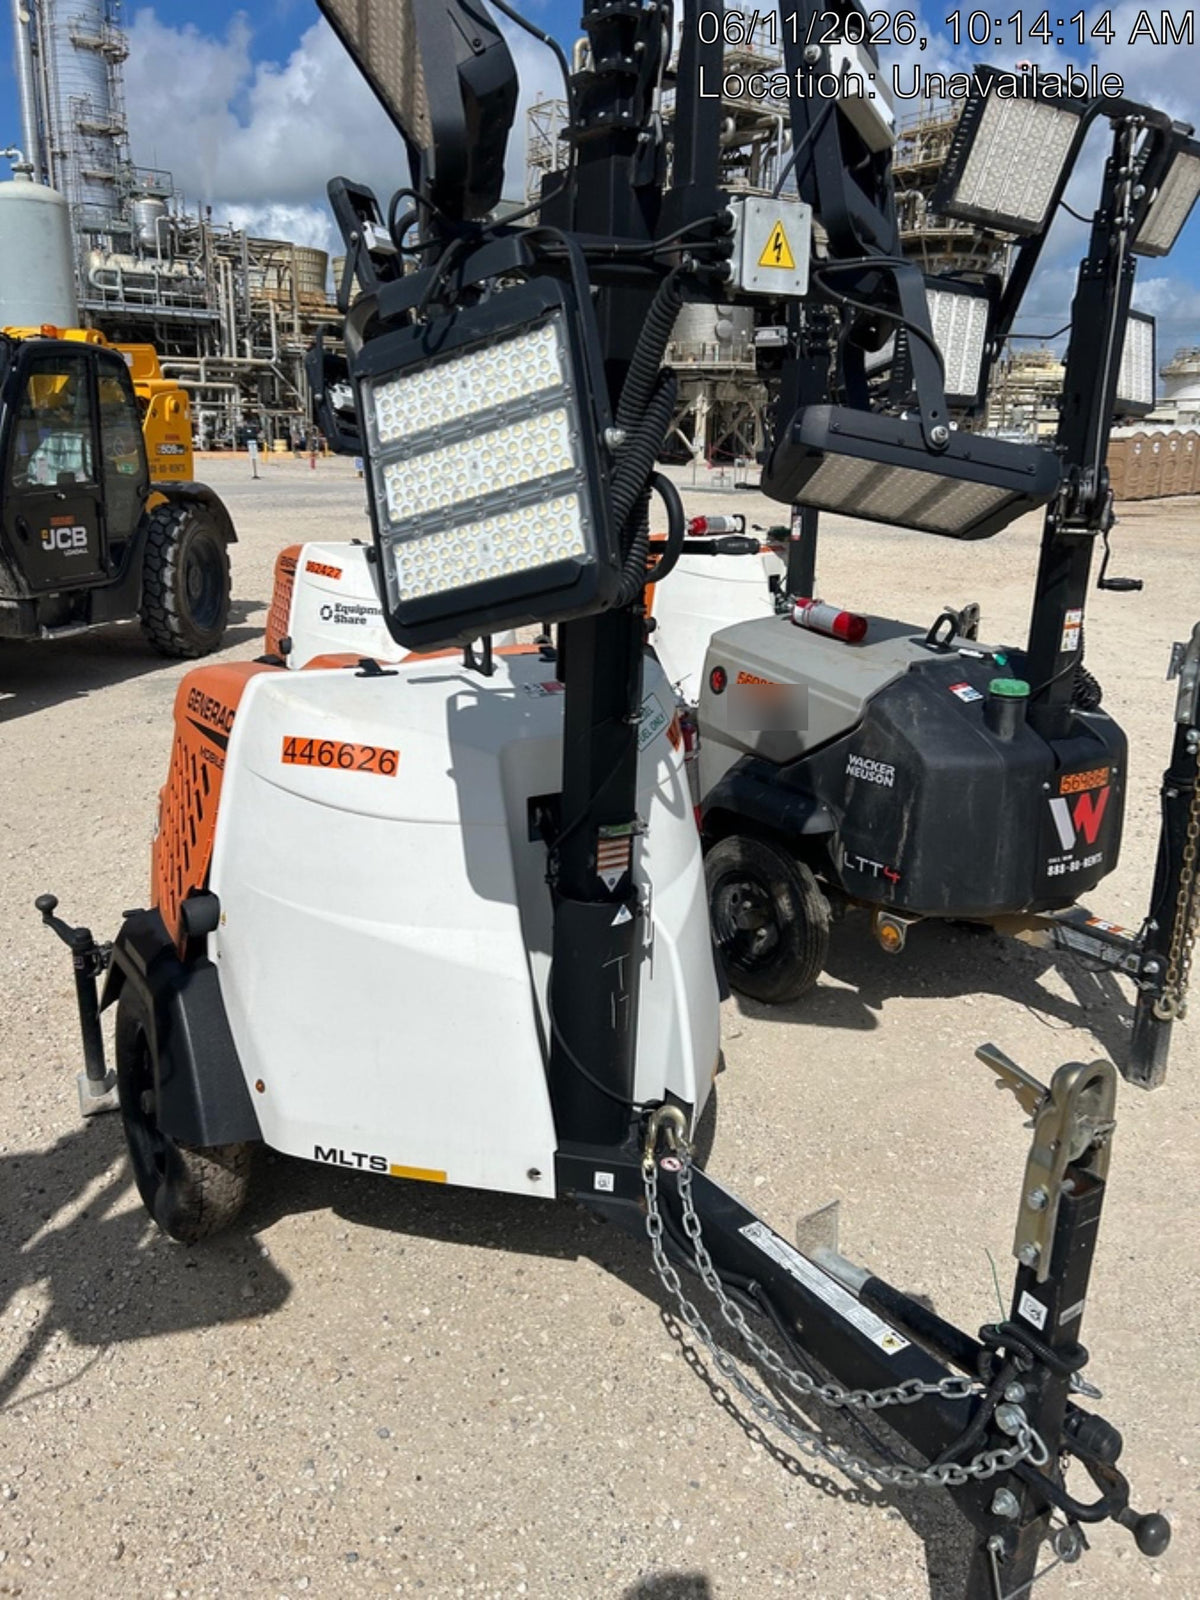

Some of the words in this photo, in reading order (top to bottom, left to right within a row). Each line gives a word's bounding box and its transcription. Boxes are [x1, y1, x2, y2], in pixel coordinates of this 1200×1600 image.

[42, 526, 88, 550] JCB
[333, 614, 367, 625] Share
[282, 737, 397, 775] 446626
[848, 753, 896, 777] WACKER
[845, 763, 895, 788] NEUSON
[843, 851, 901, 885] LTT4
[314, 1144, 388, 1173] MLTS
